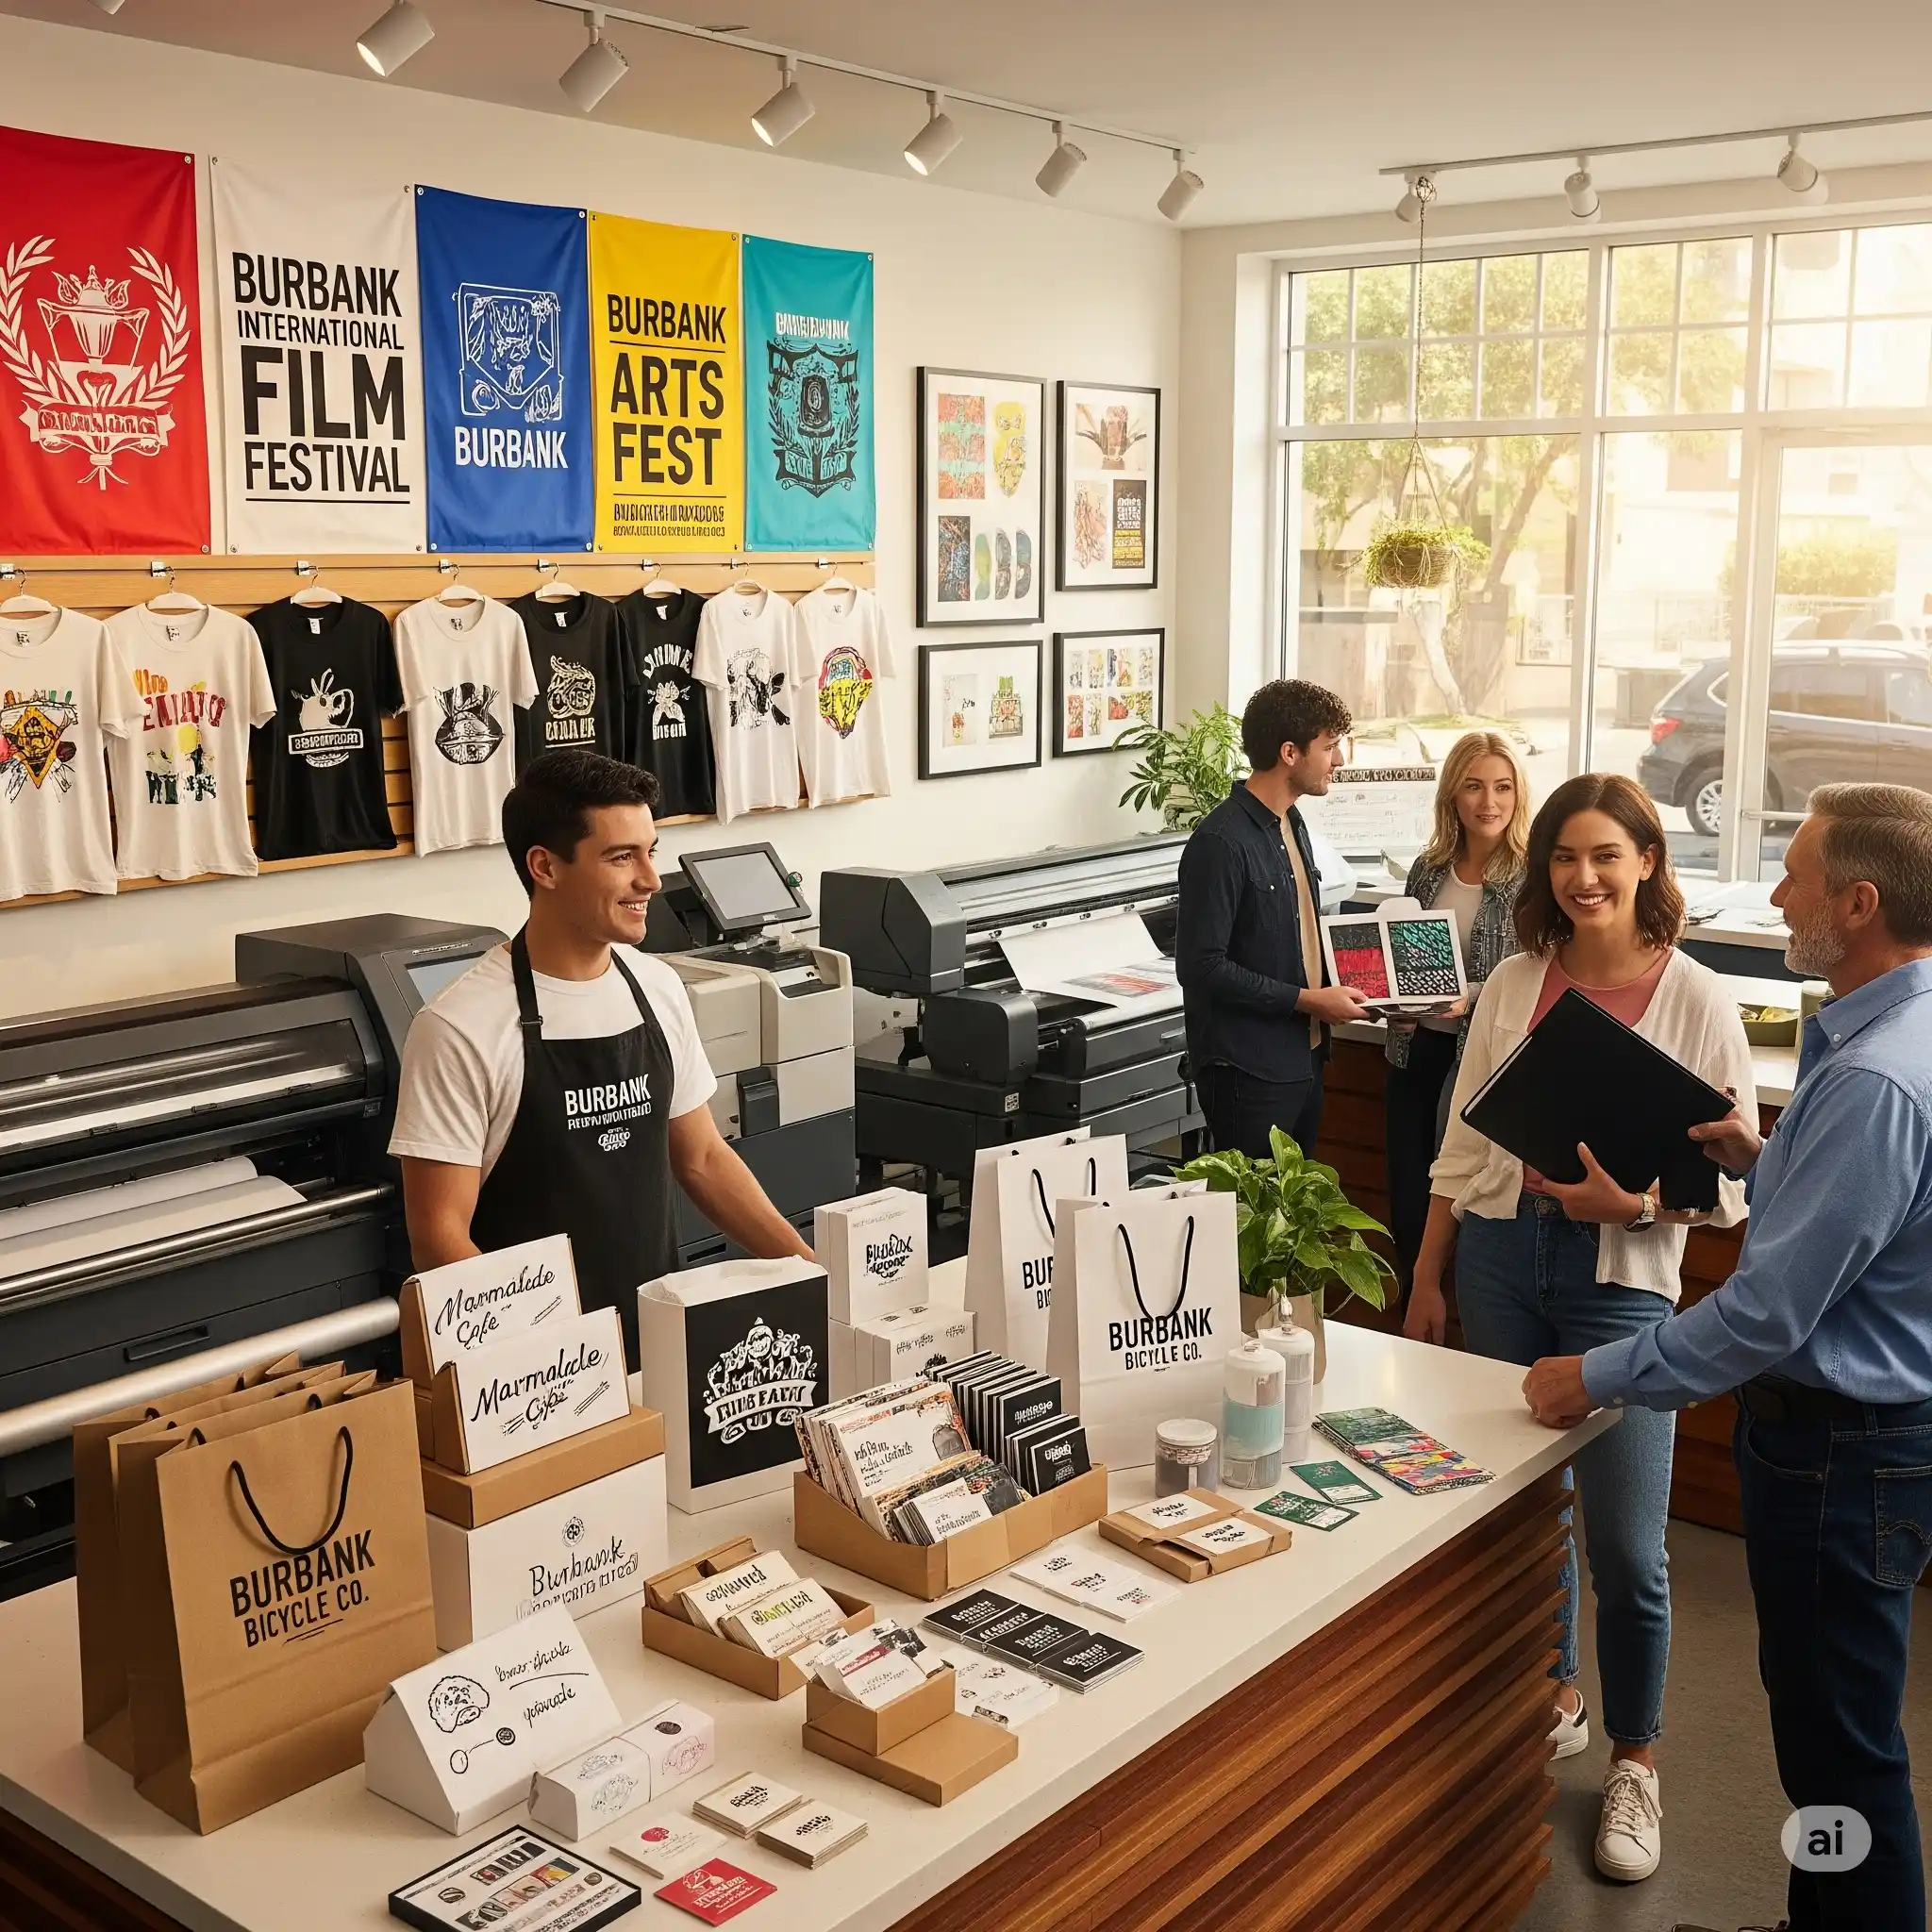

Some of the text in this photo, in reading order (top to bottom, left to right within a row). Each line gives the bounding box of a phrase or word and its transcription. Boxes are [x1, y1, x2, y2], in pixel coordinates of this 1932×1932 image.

[232, 252, 402, 317] BURBANK
[237, 310, 405, 350] INTERNATIONAL
[607, 294, 727, 343] BURBANK
[240, 344, 406, 441] FILM
[610, 352, 724, 419] ARTS
[245, 441, 409, 492] FESTIVAL
[454, 426, 568, 469] BURBANK
[612, 422, 723, 485] FEST
[565, 1074, 651, 1116] BURBANK
[1108, 1307, 1213, 1351] BURBANK
[1183, 1341, 1202, 1360] CO.
[229, 1529, 375, 1618] BURBANK
[243, 1579, 370, 1648] BICYCLE CO.
